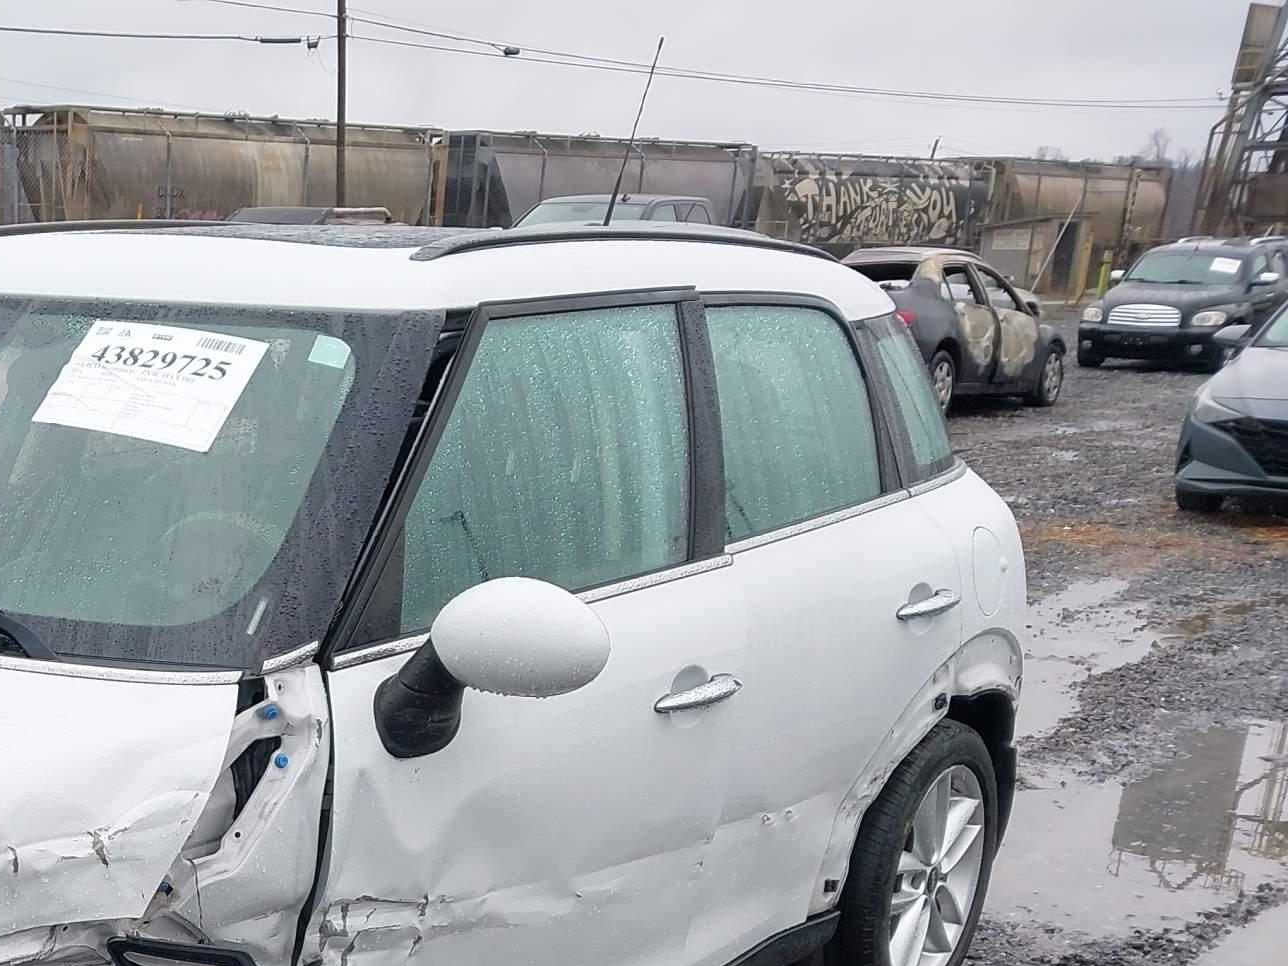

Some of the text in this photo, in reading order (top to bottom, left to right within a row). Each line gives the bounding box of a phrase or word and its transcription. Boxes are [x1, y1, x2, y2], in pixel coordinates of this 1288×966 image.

[796, 178, 880, 225] THANK
[905, 182, 957, 223] YOU
[91, 344, 233, 381] 43829725
